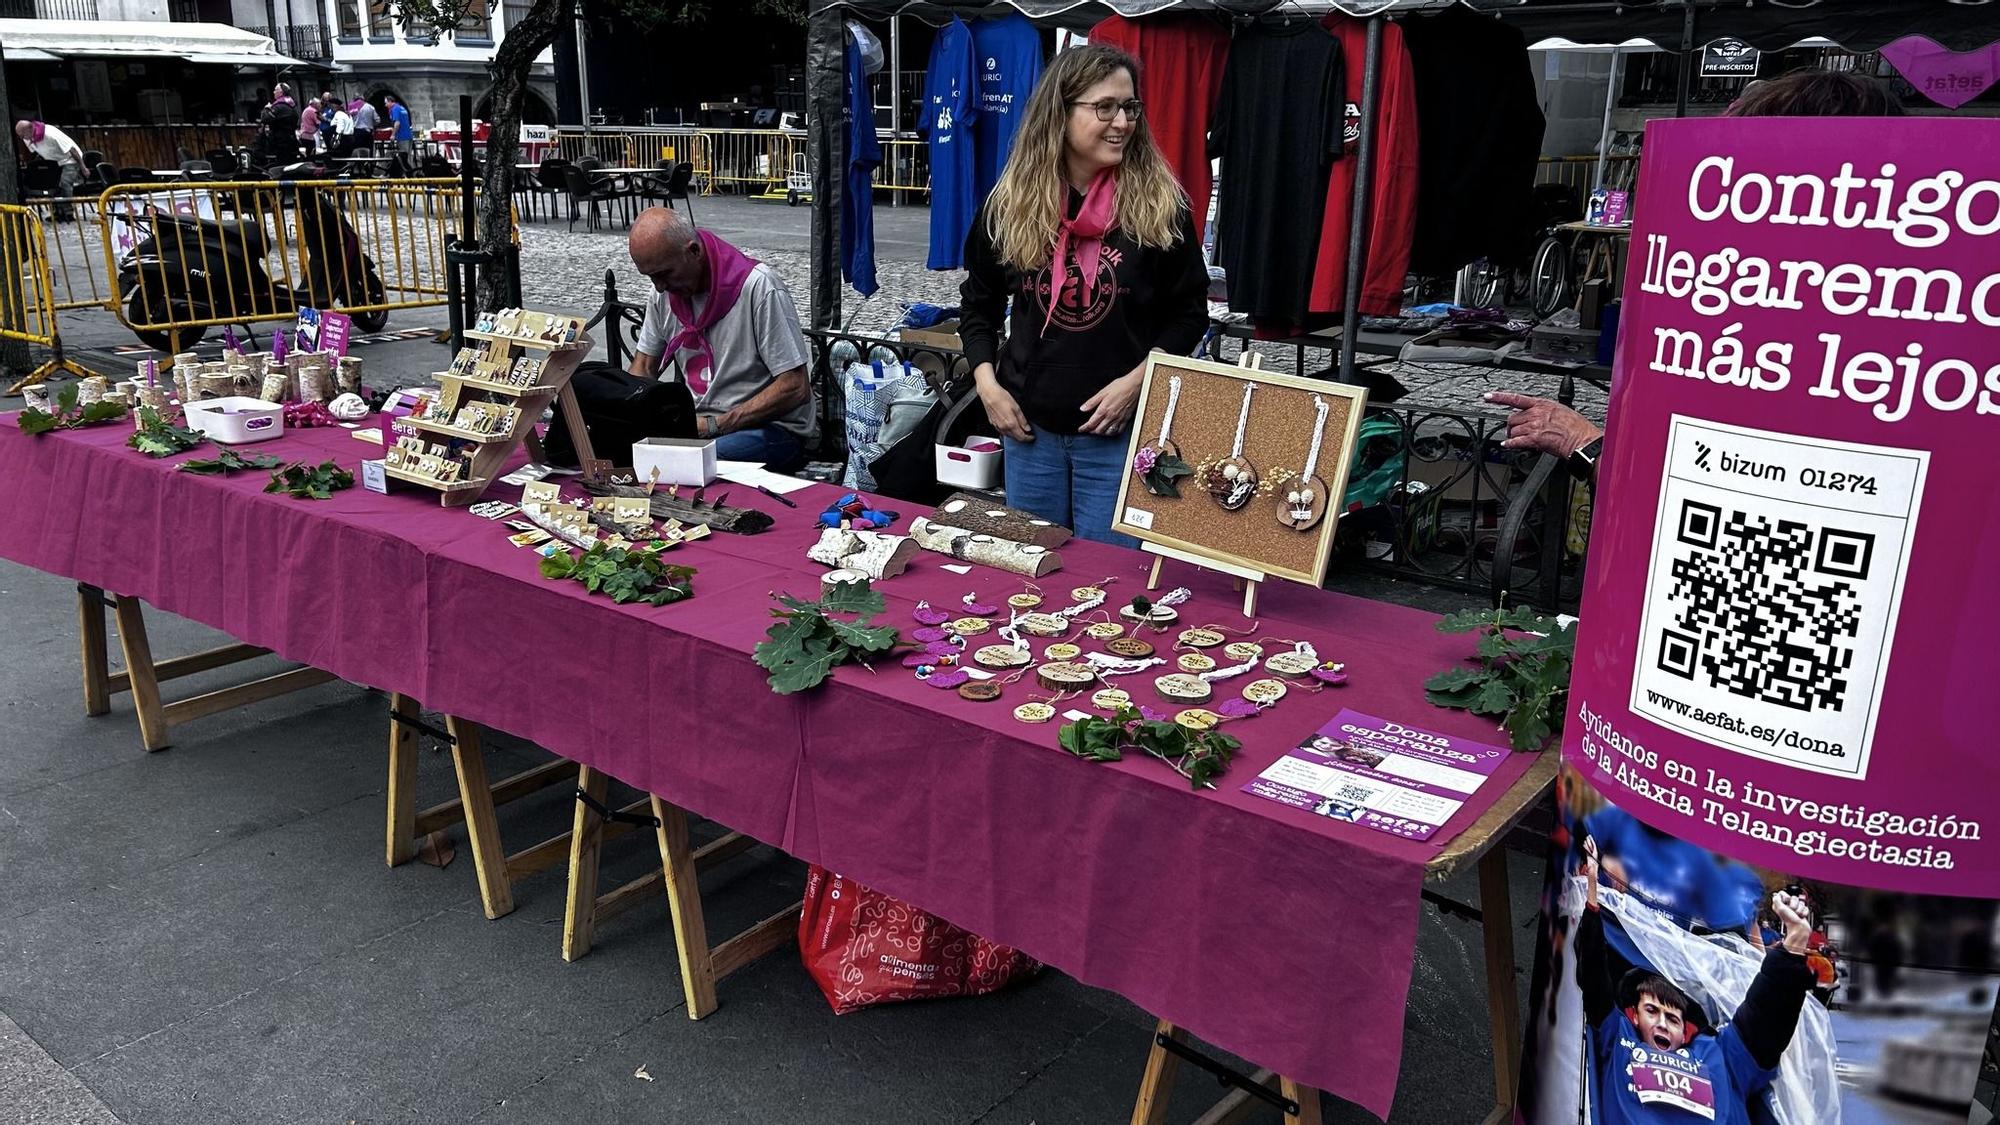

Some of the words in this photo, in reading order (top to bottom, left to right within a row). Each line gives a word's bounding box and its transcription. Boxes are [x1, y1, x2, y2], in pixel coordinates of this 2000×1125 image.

[526, 128, 546, 140] hazi
[1688, 155, 2000, 248] Contigo
[1649, 322, 1793, 392] más
[1719, 450, 1786, 483] bizum
[1799, 467, 1878, 496] 01274
[1340, 724, 1477, 763] esperanza
[1380, 722, 1450, 747] Dona
[1646, 687, 1845, 758] www.aefat.es/dona
[1578, 700, 1658, 769] Ayúdanos
[1664, 759, 1698, 785] en
[1706, 768, 1735, 799] la
[1742, 781, 1981, 841] investigación
[1366, 812, 1431, 834] aefat
[1581, 735, 1597, 756] de
[1598, 746, 1613, 774] la
[1613, 761, 1695, 816] Ataxia
[1702, 801, 1954, 870] Telangiectasia
[1649, 1053, 1699, 1074] ZURICH
[1653, 1069, 1693, 1095] 104
